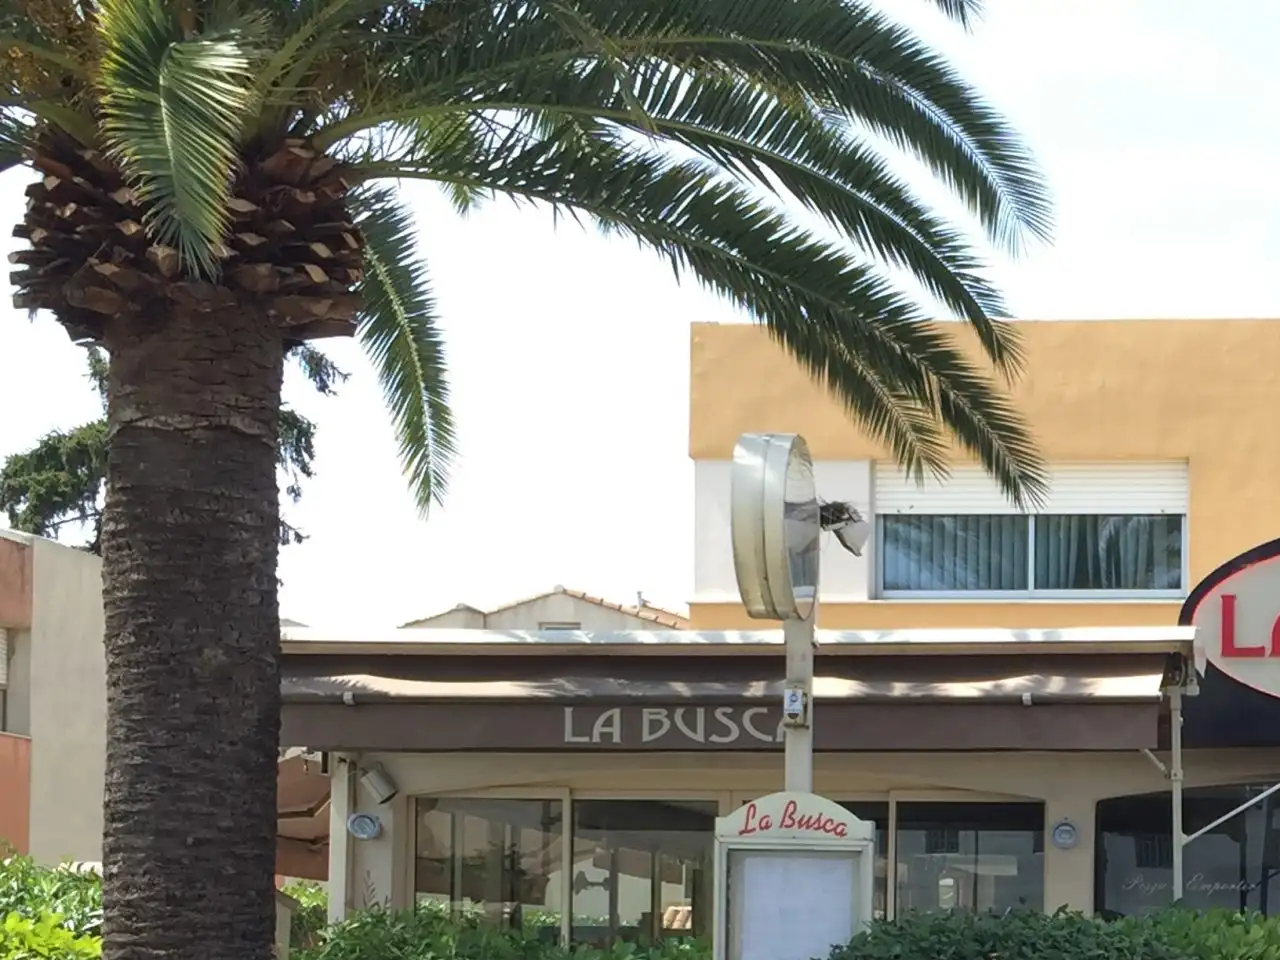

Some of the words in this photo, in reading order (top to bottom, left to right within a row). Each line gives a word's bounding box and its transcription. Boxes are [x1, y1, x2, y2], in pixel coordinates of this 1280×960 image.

[563, 707, 622, 744] LA
[738, 803, 773, 836] La
[779, 800, 849, 838] Busca
